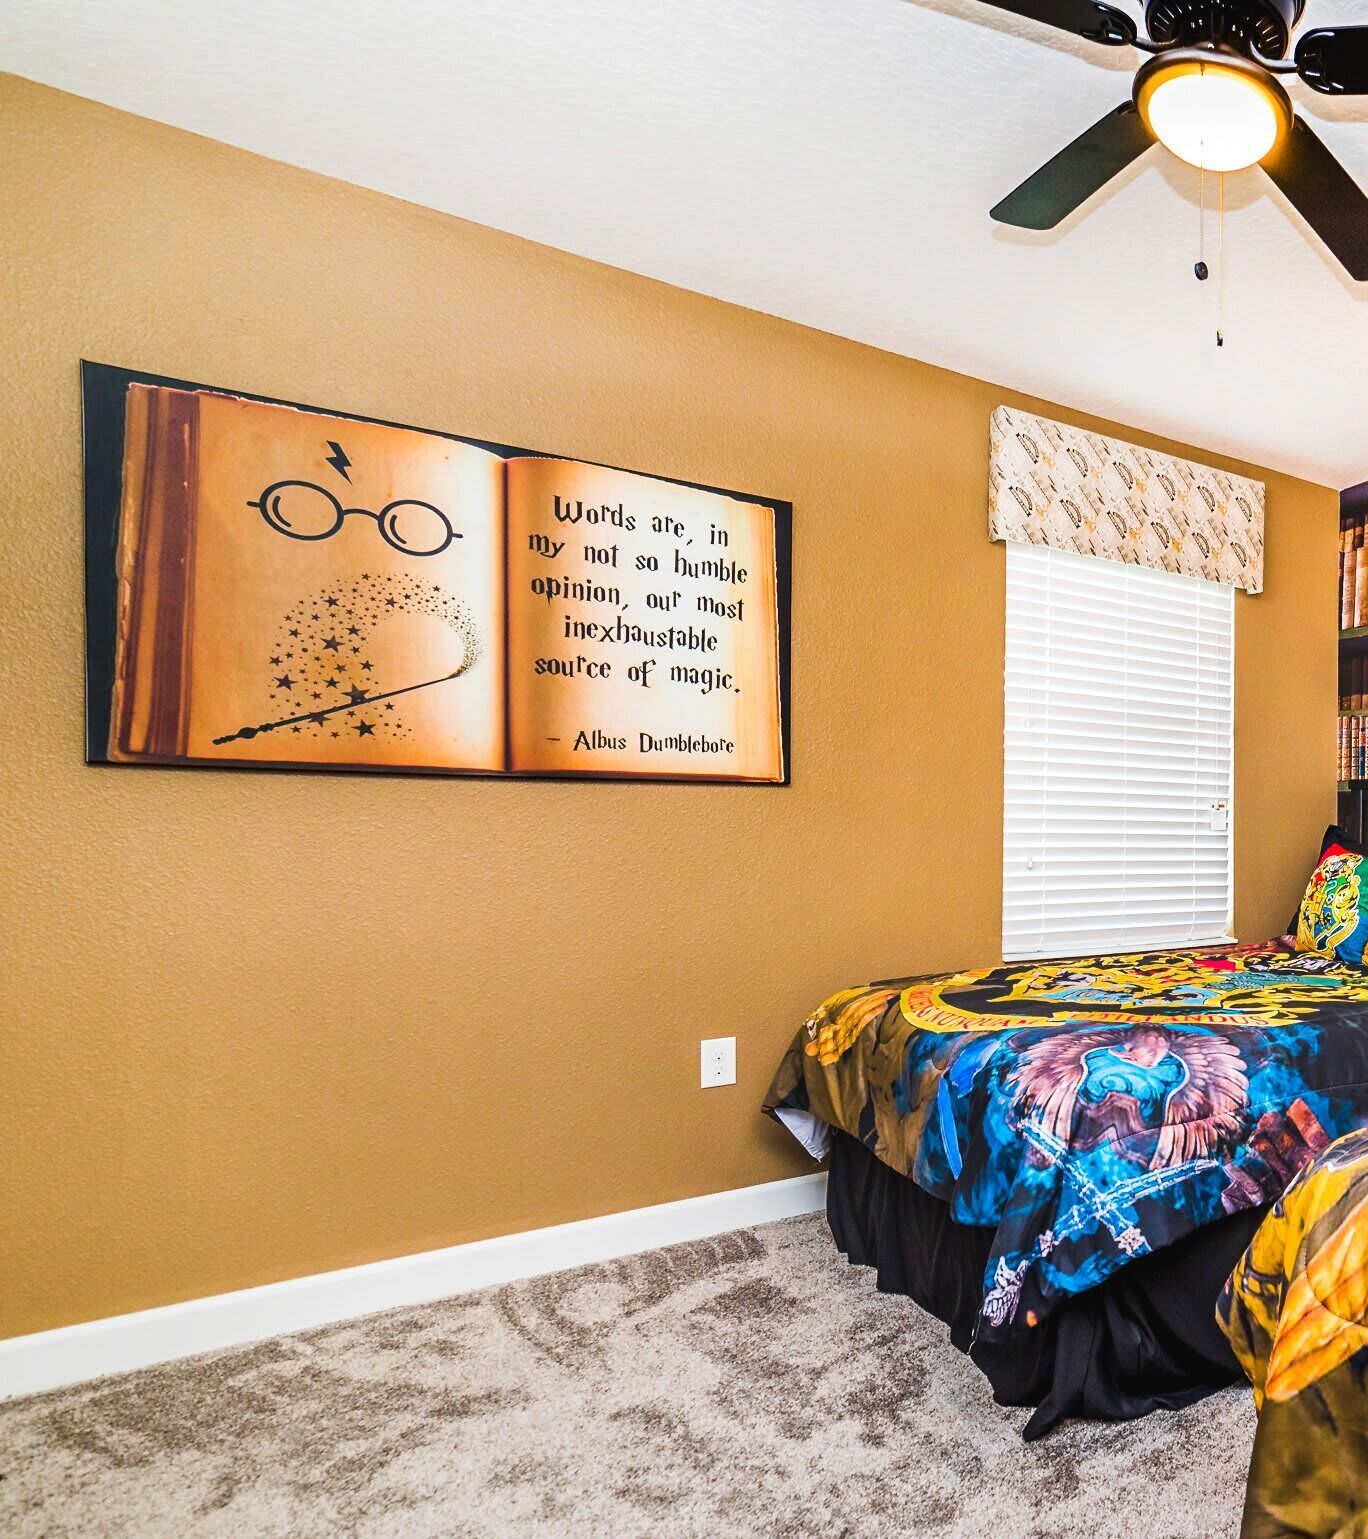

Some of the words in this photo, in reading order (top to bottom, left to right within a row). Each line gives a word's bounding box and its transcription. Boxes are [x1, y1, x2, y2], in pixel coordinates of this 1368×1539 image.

[553, 495, 637, 532] Words
[652, 514, 693, 546] are,
[710, 523, 729, 548] in
[528, 533, 566, 558] my
[584, 544, 619, 568] not
[635, 553, 659, 572] so
[674, 549, 748, 585] humble
[531, 576, 629, 612] opinion,
[646, 591, 681, 612] our
[697, 594, 744, 621] most
[564, 615, 718, 653] inexhaustable
[534, 655, 612, 679] source
[627, 659, 656, 688] of
[670, 663, 741, 695] magic.
[573, 729, 627, 752] Albus
